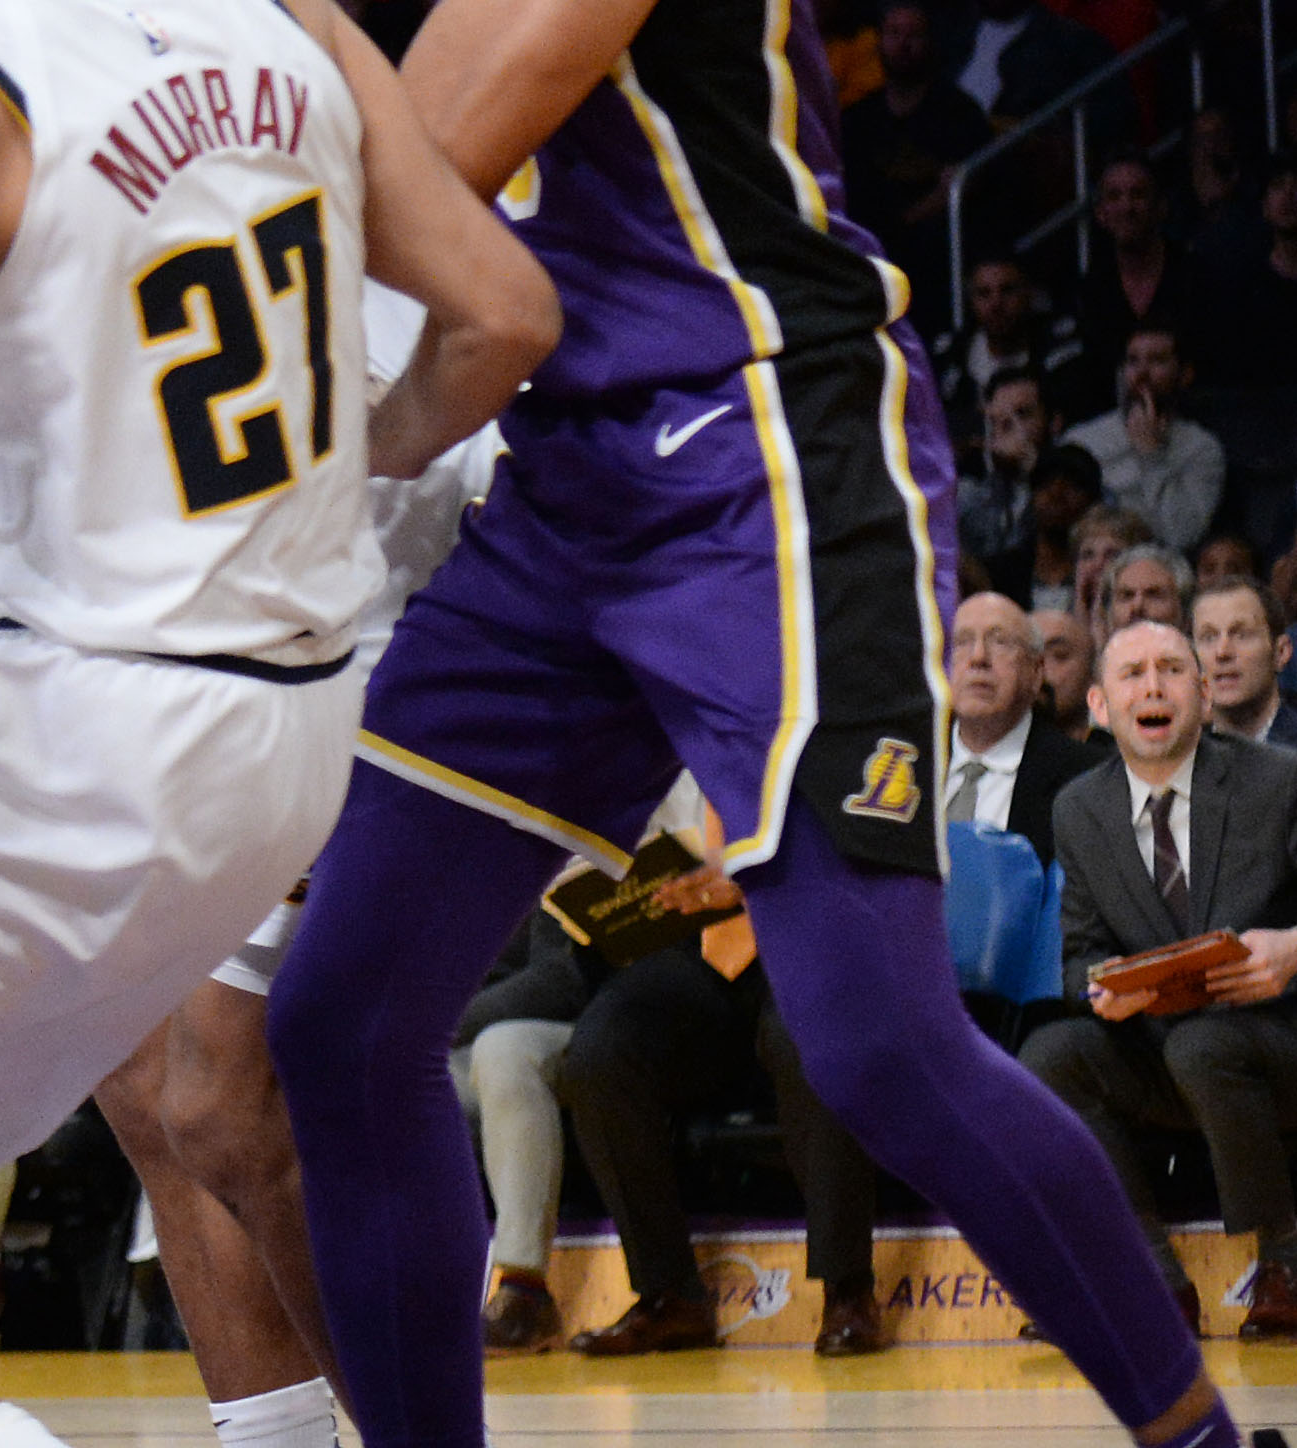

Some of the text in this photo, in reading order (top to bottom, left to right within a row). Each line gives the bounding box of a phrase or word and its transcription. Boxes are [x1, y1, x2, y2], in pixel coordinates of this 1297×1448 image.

[88, 67, 308, 216] MURRAY
[129, 186, 335, 521] 27
[887, 1272, 1005, 1310] AKER
